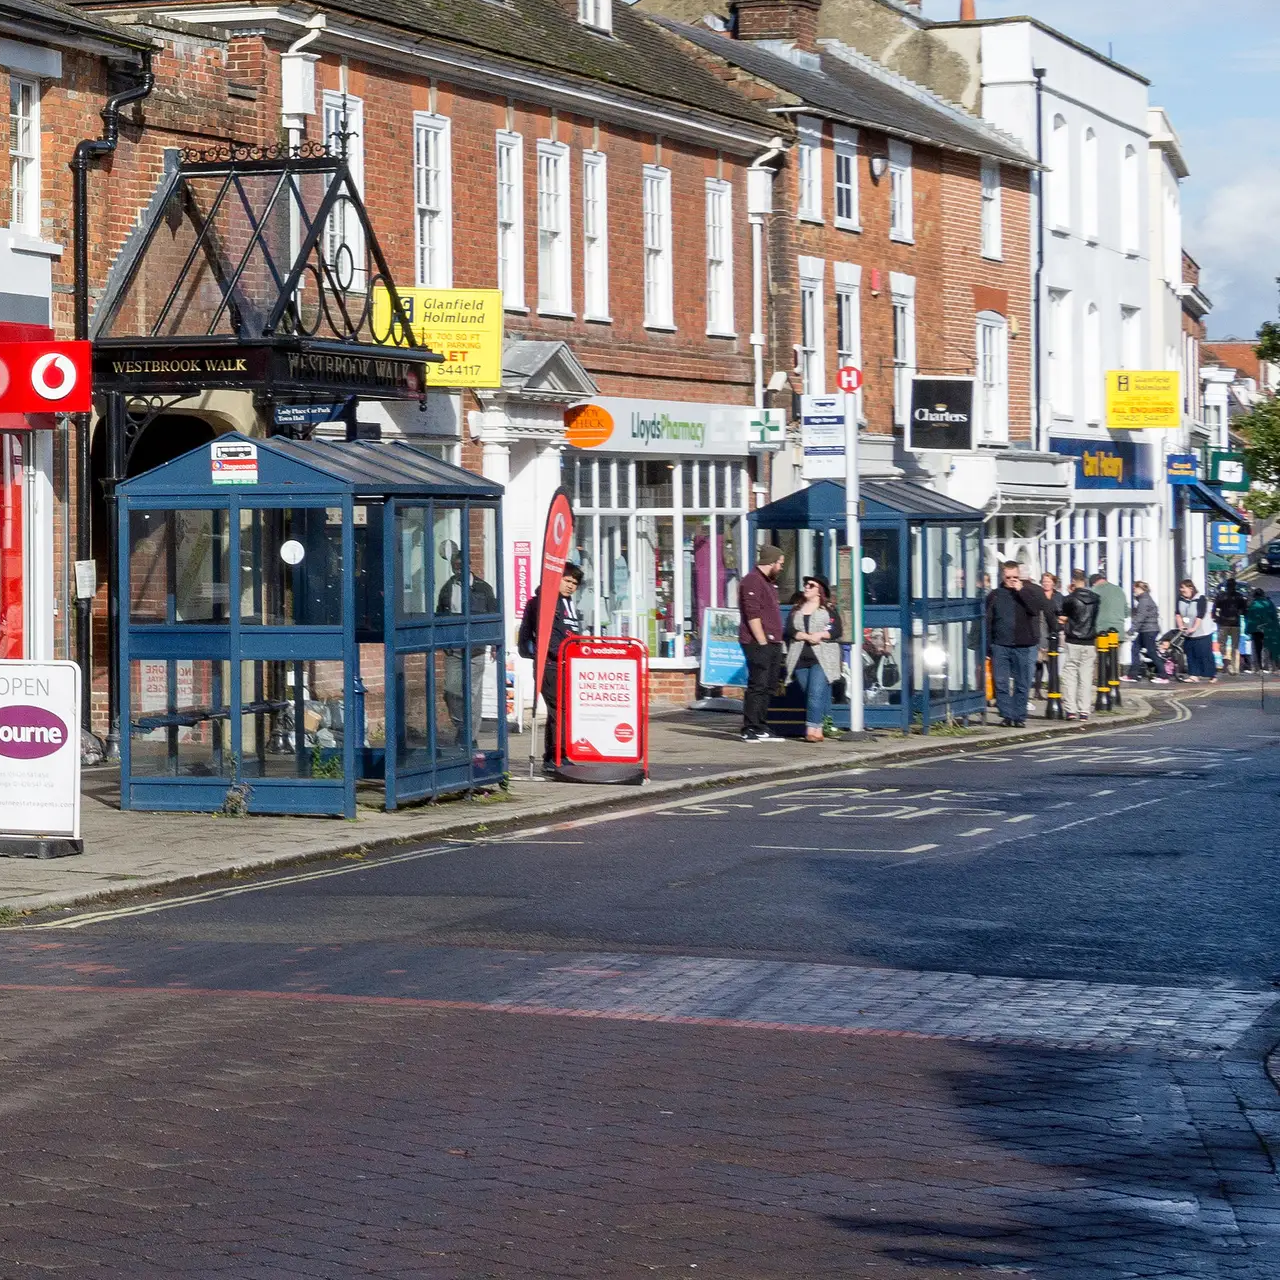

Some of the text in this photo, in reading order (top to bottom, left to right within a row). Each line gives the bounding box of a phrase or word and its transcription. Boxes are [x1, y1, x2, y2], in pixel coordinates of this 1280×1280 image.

[423, 298, 484, 310] Glanfield
[423, 312, 485, 324] Holmlund
[470, 333, 481, 341] FT
[112, 358, 247, 373] WESTBROOK WALK
[287, 352, 371, 378] WESTBROOK
[374, 359, 411, 379] WALK
[437, 365, 481, 376] 544117
[841, 370, 858, 388] H
[914, 408, 968, 423] Charters
[631, 412, 706, 447] LloydsPharmacy
[518, 557, 527, 610] MASSAGE
[591, 647, 628, 655] vodafone
[578, 671, 631, 682] NO MORE
[578, 682, 630, 691] LINE RENTAL
[579, 692, 631, 702] CHARGES
[760, 788, 1022, 802] BUS
[655, 803, 1008, 819] STOP
